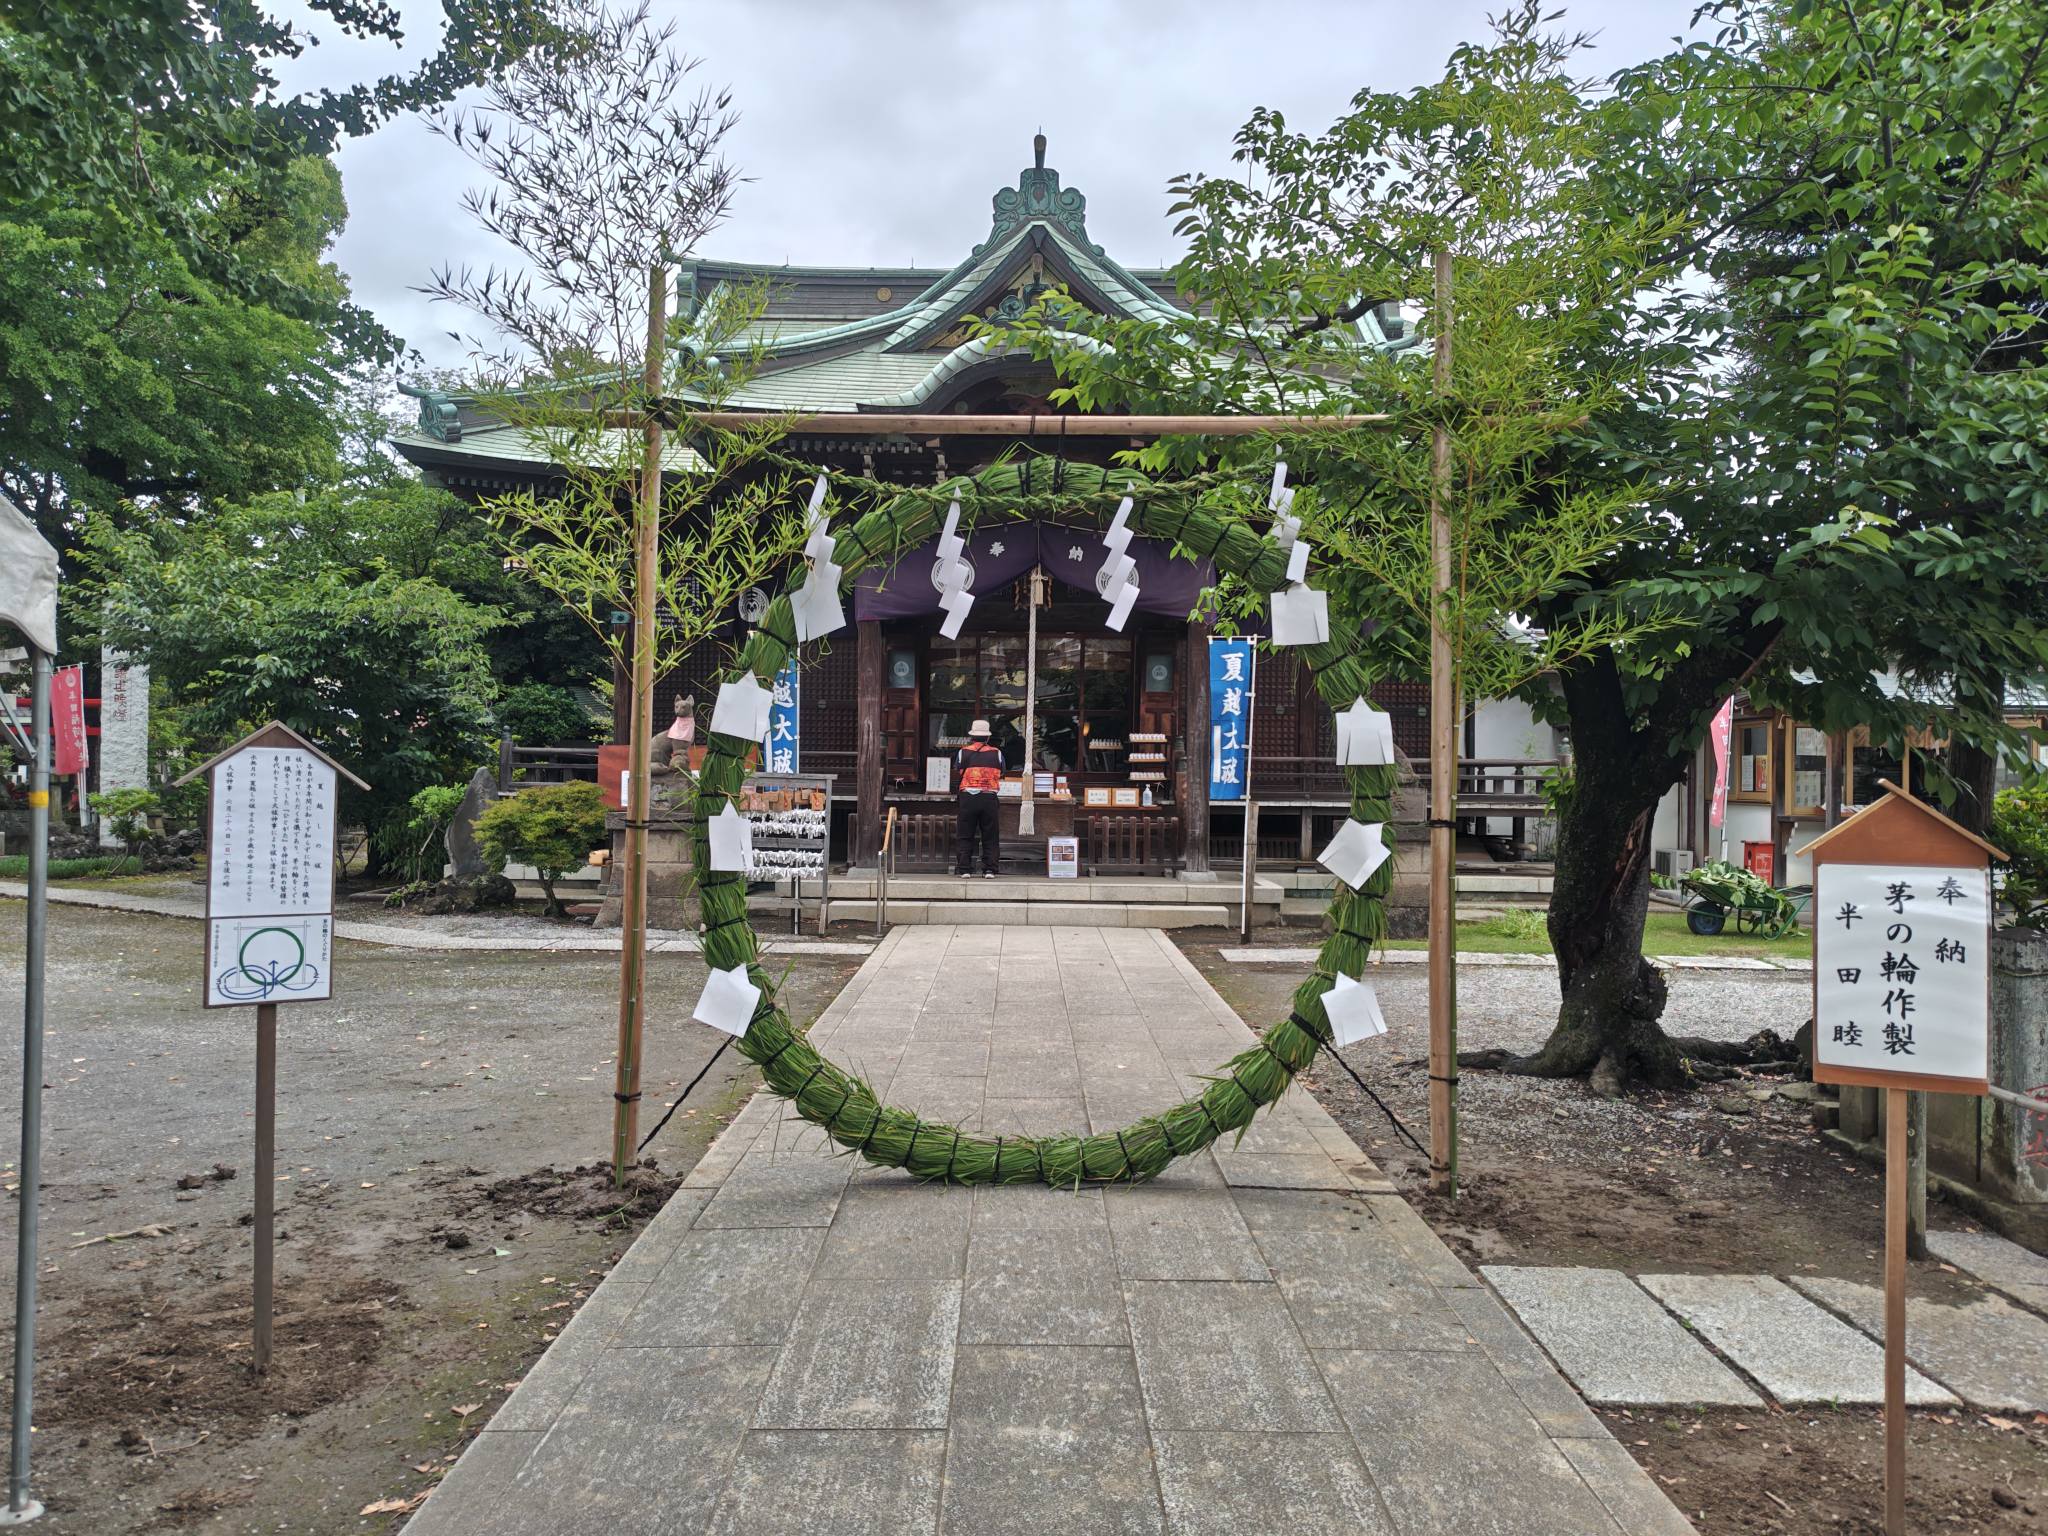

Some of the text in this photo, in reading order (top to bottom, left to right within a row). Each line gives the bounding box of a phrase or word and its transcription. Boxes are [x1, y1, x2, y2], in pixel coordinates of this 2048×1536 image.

[988, 541, 1084, 562] 奉 納
[772, 671, 796, 774] 越大祓
[1220, 652, 1244, 784] 夏越大祓
[1832, 902, 1863, 1047] 半田睦
[1879, 882, 1919, 1056] 茅の輪作製
[1934, 876, 1968, 964] 奉納
